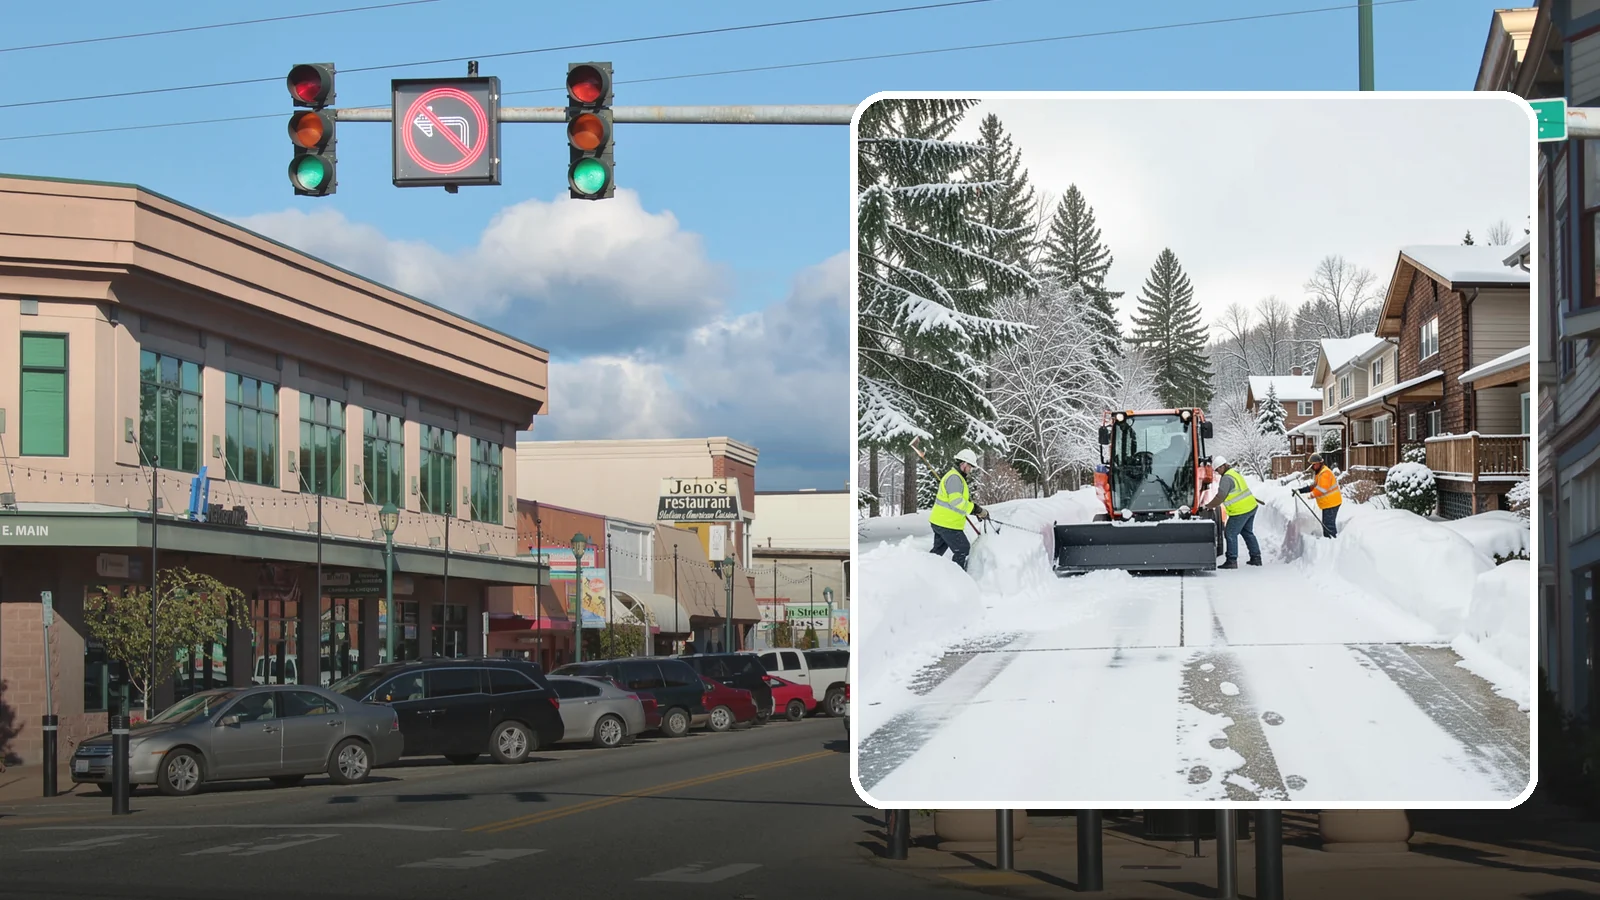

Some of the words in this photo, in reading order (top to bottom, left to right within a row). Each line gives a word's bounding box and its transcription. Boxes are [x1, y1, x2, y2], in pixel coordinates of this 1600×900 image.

[670, 480, 727, 494] Jeno's
[665, 497, 731, 509] restaurant
[658, 510, 681, 519] Italian
[686, 510, 714, 519] American
[714, 509, 737, 519] Cuisine
[2, 525, 13, 536] E.
[15, 525, 49, 536] MAIN
[797, 607, 828, 617] Street
[791, 619, 823, 627] lass
